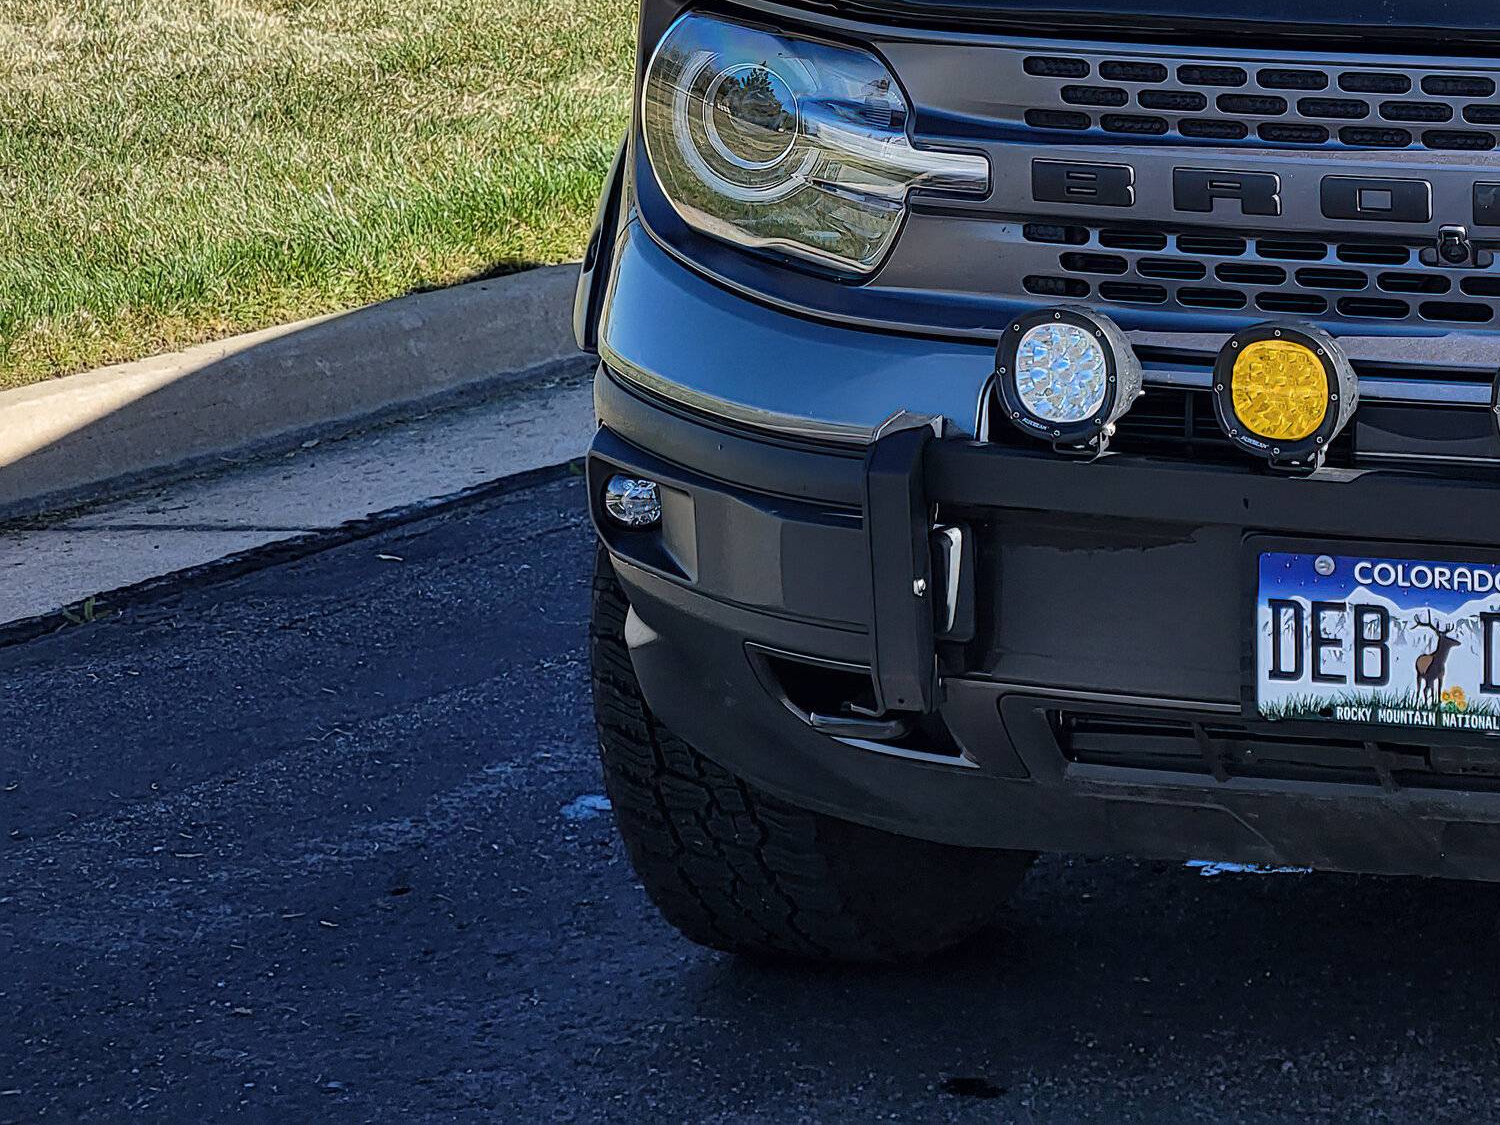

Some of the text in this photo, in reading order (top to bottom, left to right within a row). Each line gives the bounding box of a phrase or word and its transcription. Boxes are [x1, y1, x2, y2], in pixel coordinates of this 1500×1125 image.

[1267, 598, 1390, 687] DEB
[1336, 706, 1373, 723] ROCKY
[1378, 708, 1437, 726] MOUNTAIN
[1442, 713, 1500, 731] NATIONAL
